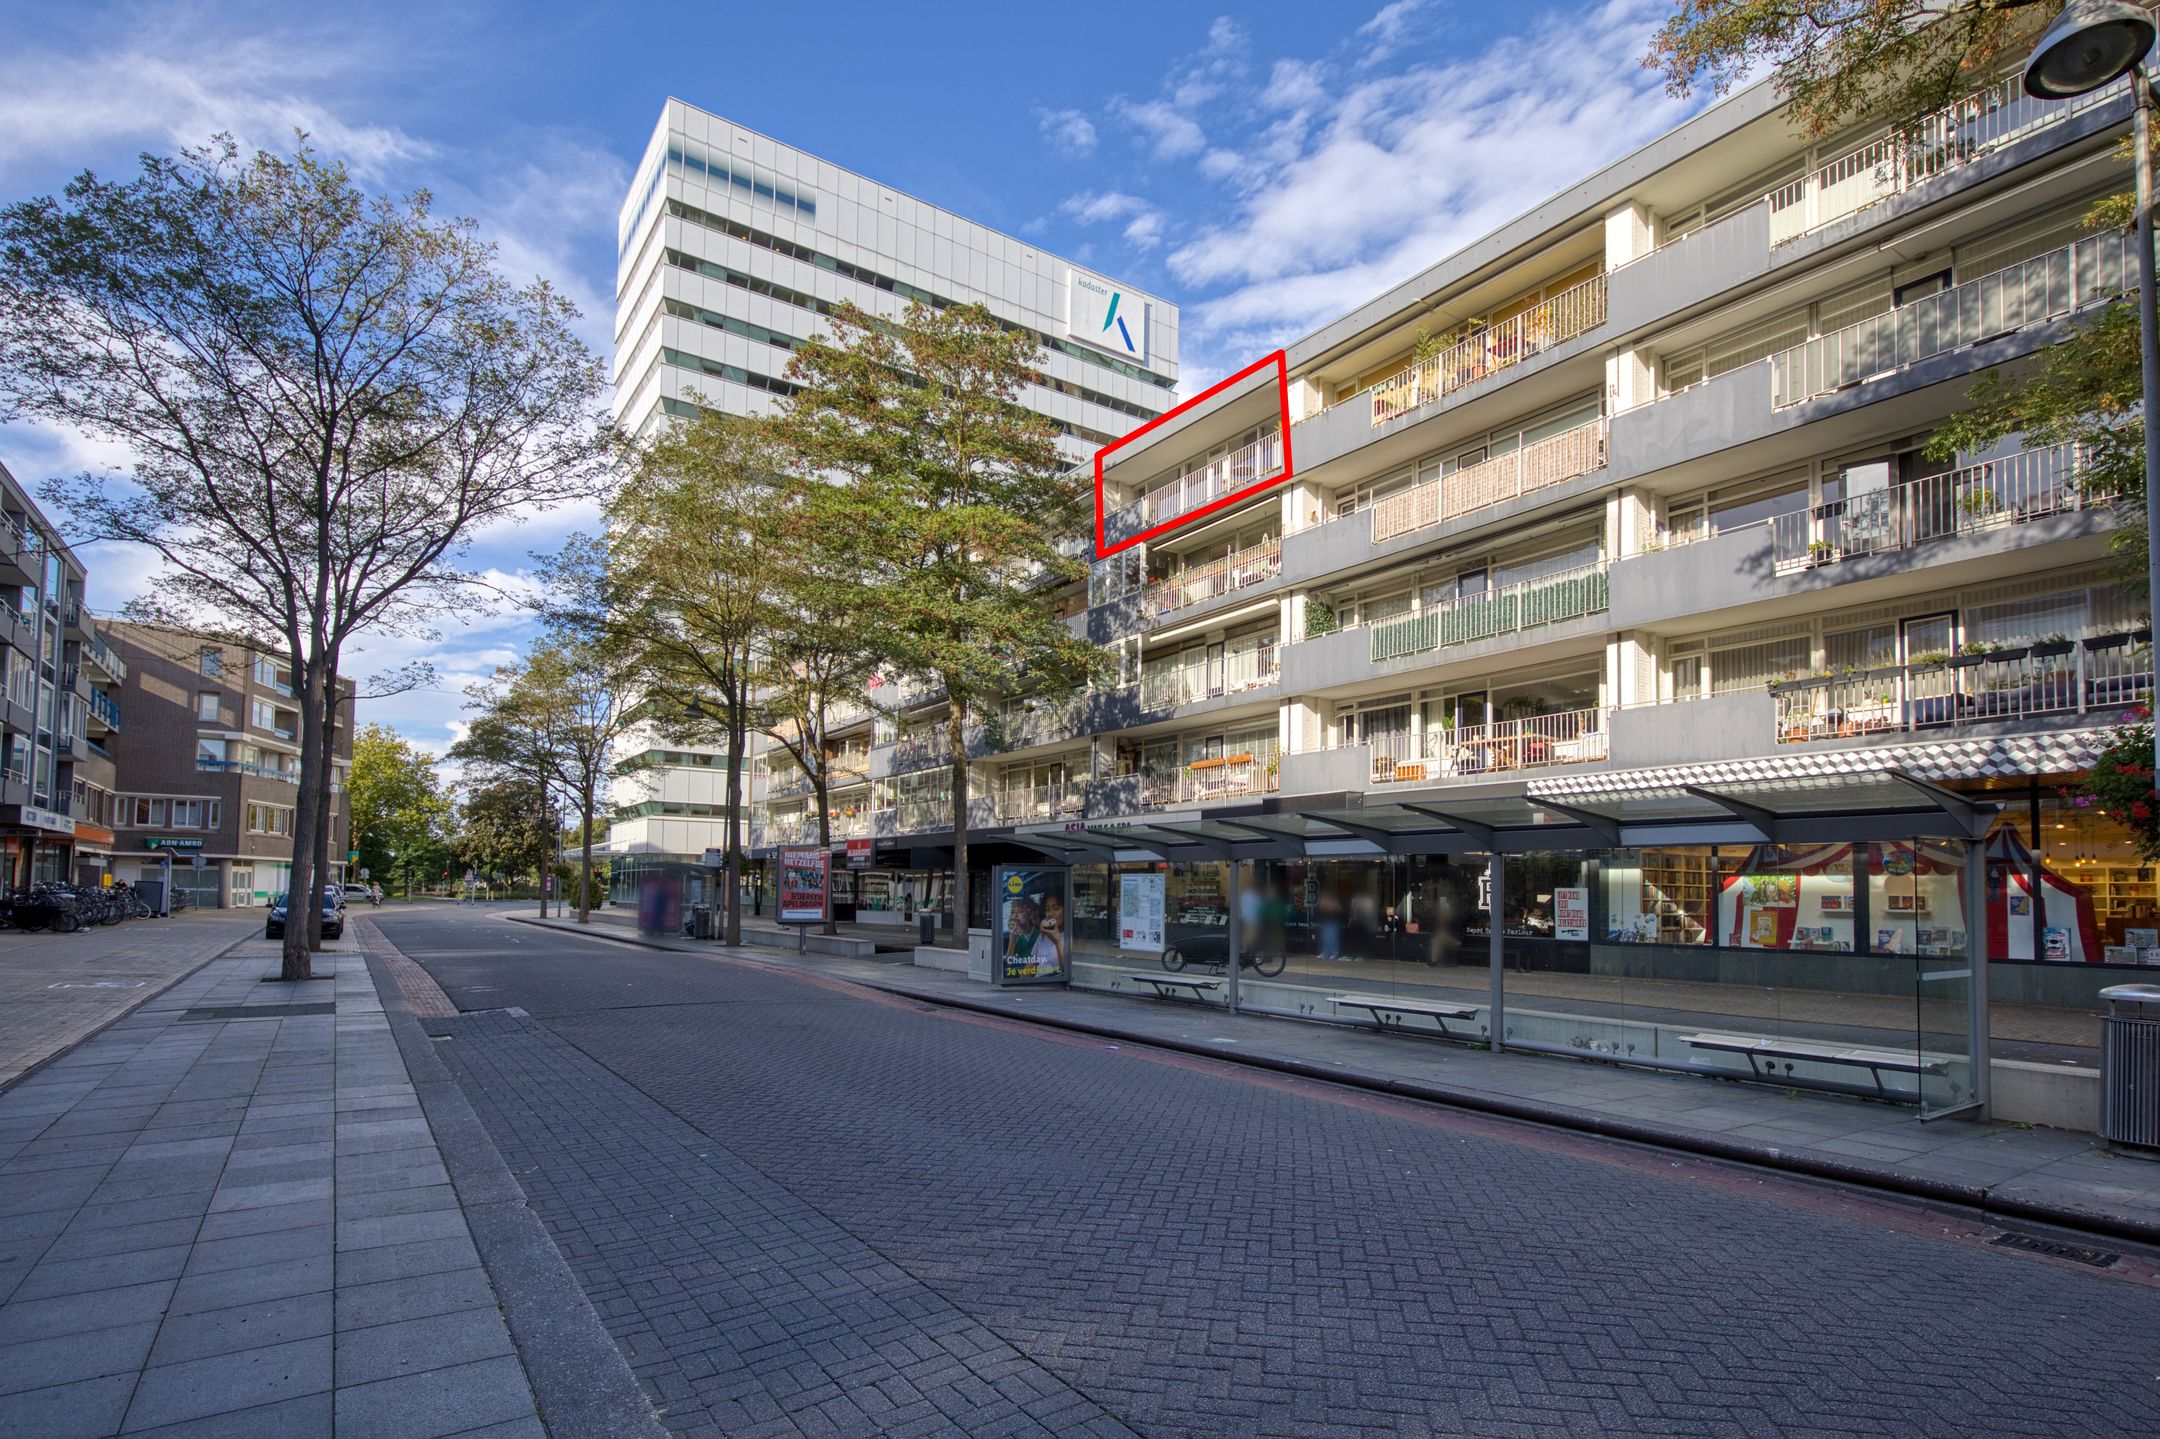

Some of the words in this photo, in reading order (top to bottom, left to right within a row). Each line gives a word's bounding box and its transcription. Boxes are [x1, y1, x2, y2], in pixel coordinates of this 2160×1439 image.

[1078, 277, 1108, 296] kadaster
[1064, 822, 1086, 832] ASIA
[784, 851, 820, 860] NIEMAND
[784, 859, 825, 869] HETZELFDE
[791, 892, 823, 901] IEDEREEN
[783, 900, 823, 910] APELDOORN
[1007, 954, 1048, 965] Cheatday.
[1007, 967, 1016, 976] Je
